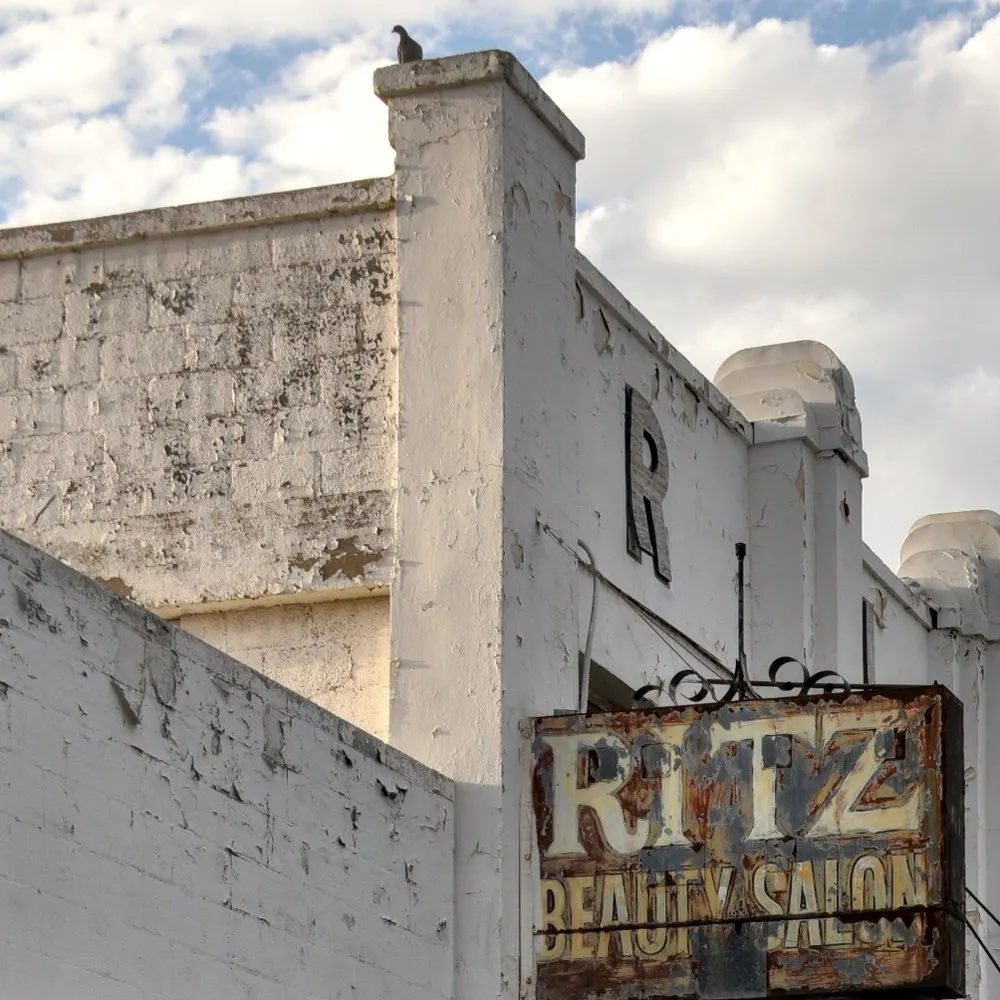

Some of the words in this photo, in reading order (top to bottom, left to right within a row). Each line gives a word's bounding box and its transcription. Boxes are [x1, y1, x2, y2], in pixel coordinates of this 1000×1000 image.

[542, 706, 922, 857] RITZ
[540, 864, 736, 960] BEAUTY
[750, 852, 930, 952] SALON
